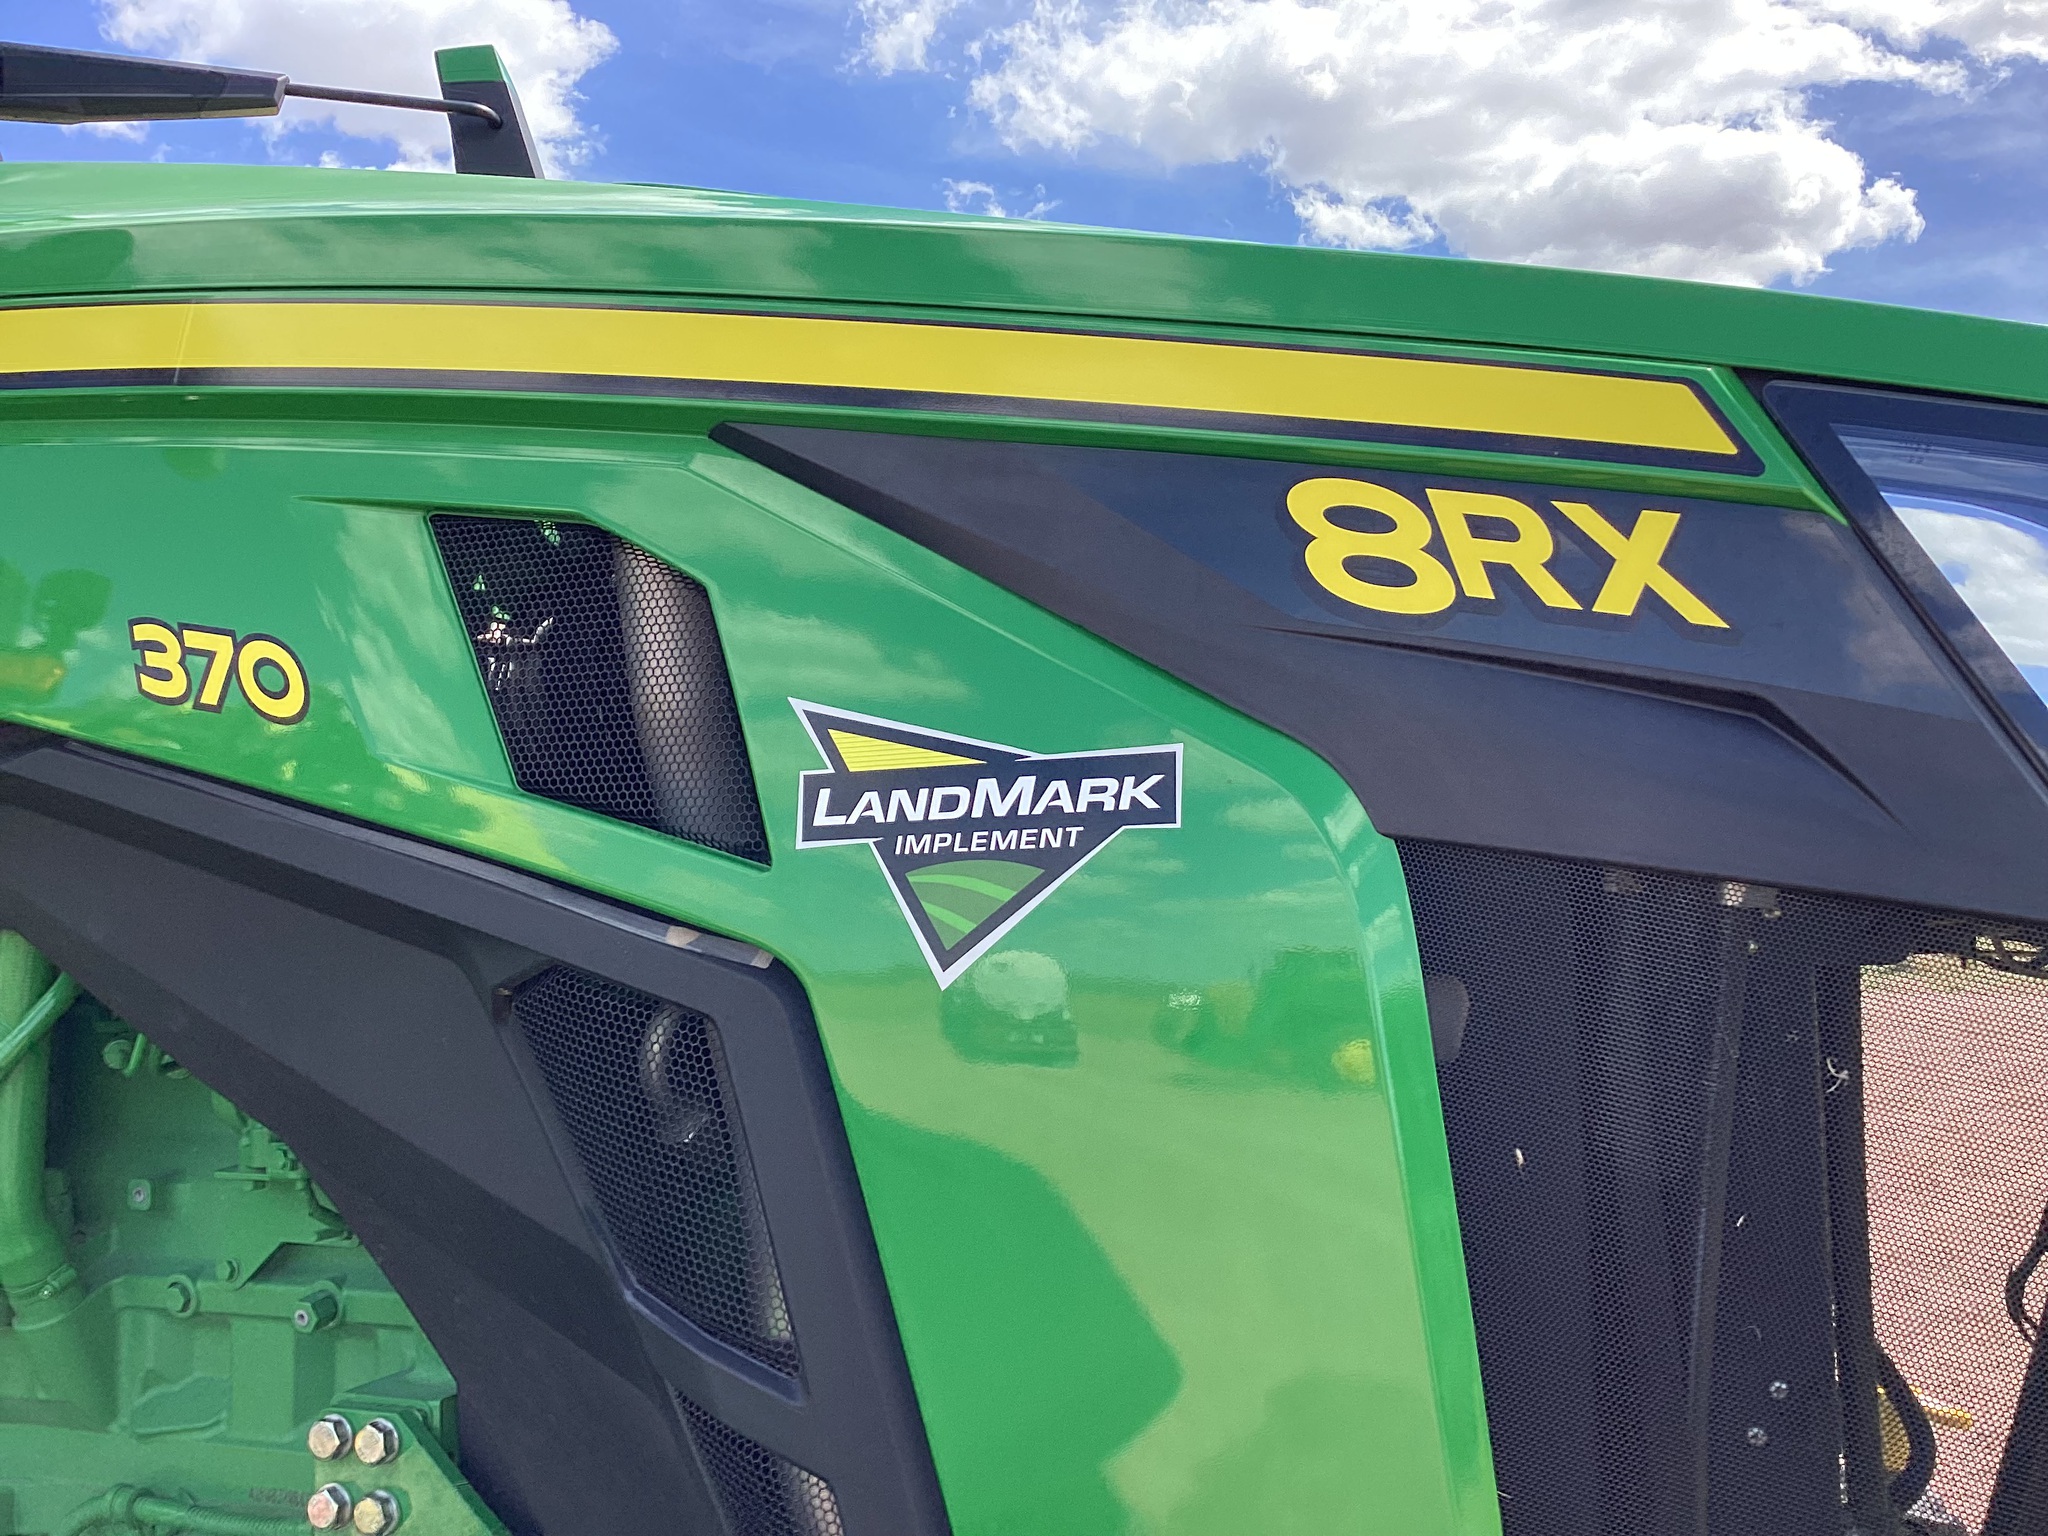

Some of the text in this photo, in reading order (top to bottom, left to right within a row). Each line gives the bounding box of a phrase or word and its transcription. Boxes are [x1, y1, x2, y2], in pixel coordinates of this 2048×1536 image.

[1286, 476, 1731, 629] 8RX
[129, 618, 309, 723] 370
[812, 774, 1166, 827] LANDMARK
[894, 826, 1084, 855] IMPLEMENT
